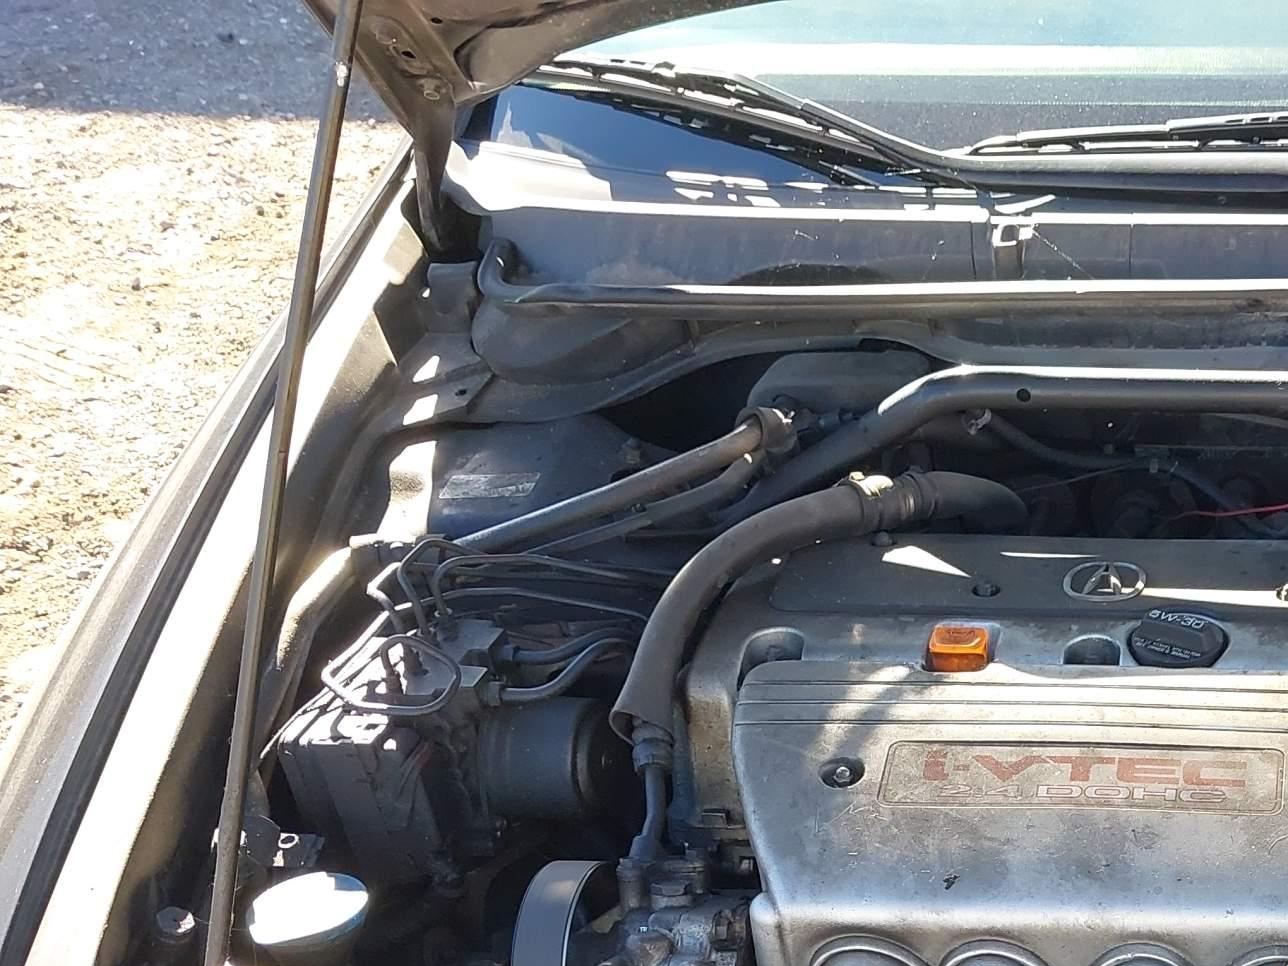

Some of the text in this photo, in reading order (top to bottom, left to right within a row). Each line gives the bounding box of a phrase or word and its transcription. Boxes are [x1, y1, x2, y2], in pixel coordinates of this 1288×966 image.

[1149, 609, 1205, 629] 5W-30
[923, 749, 1246, 787] i-VTEC
[1036, 784, 1226, 804] DOHC
